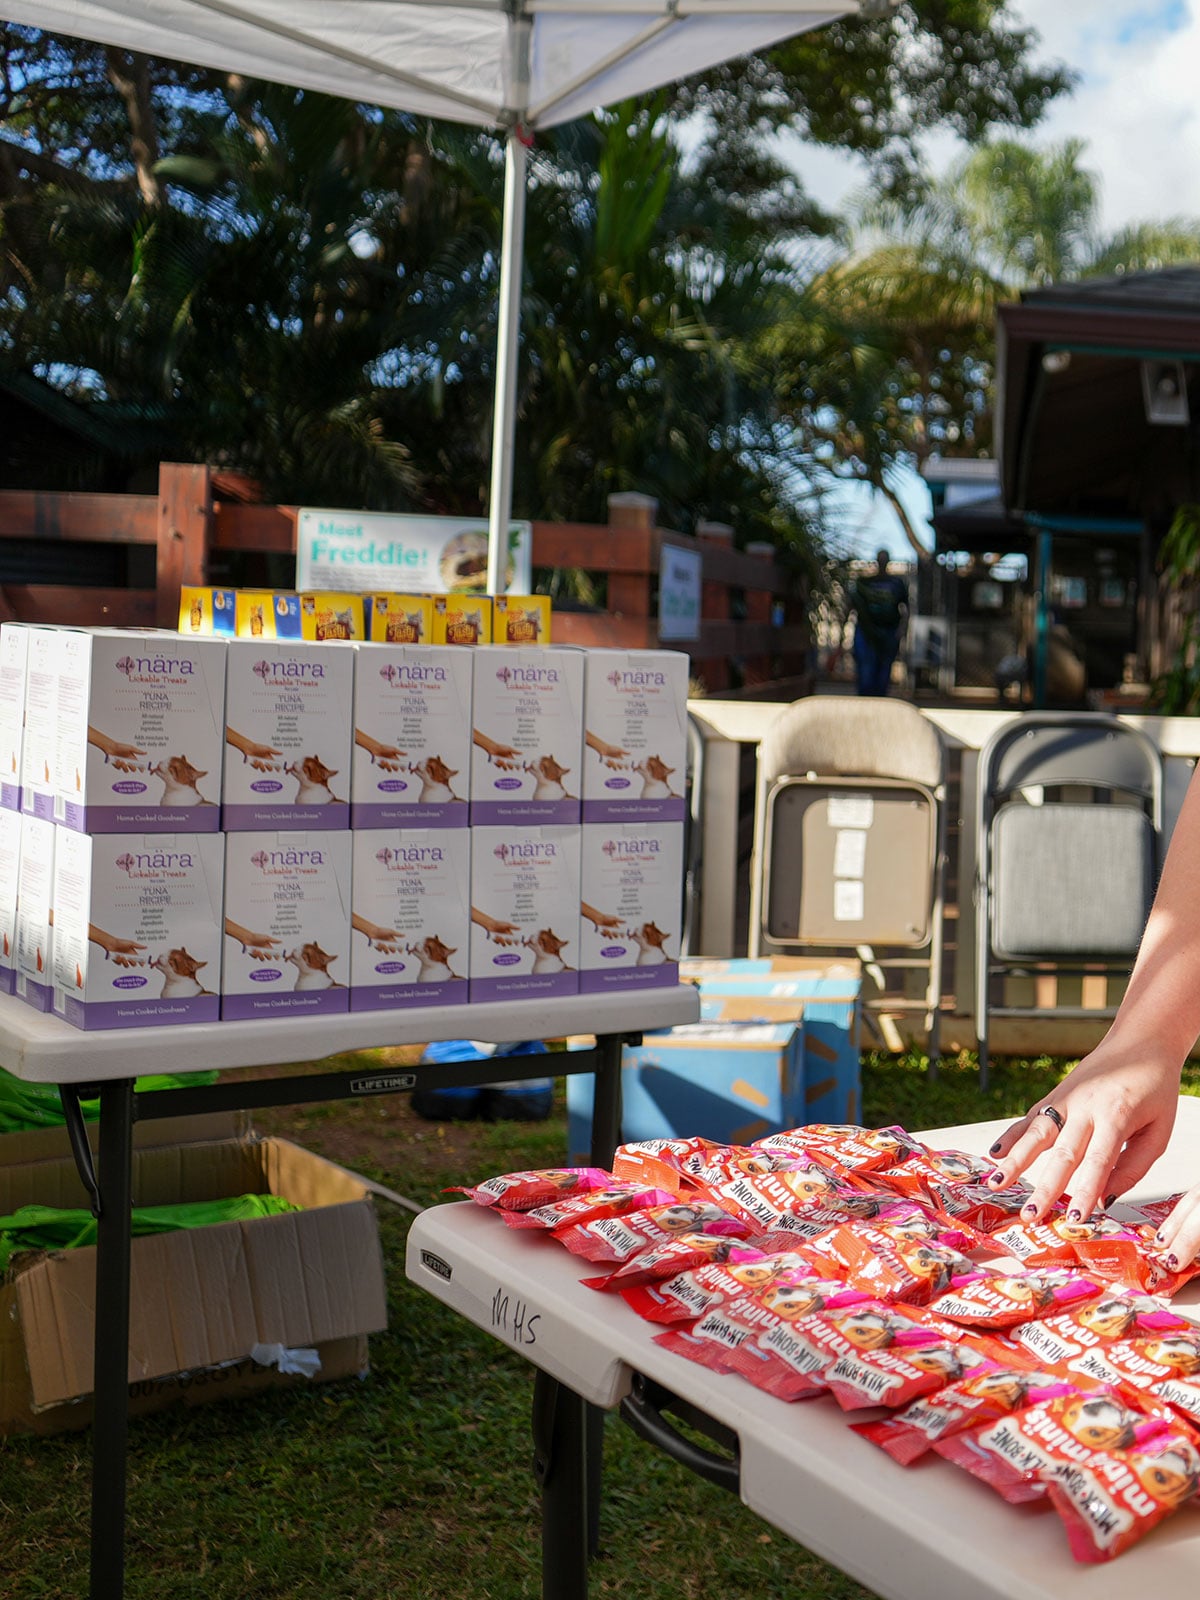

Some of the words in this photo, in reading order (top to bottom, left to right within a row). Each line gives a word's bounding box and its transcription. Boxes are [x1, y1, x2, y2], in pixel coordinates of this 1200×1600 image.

[318, 521, 363, 538] Meet
[310, 539, 428, 568] Freddie!
[128, 675, 160, 683] Lickable
[162, 676, 187, 684] Treats
[264, 678, 293, 686] Lickable
[296, 679, 318, 687] Treats
[143, 692, 168, 700] TUNA
[278, 695, 302, 703] TUNA
[140, 701, 172, 710] RECIPE
[274, 704, 304, 712] RECIPE
[136, 850, 194, 868] nära
[128, 870, 160, 879] Lickable
[162, 870, 186, 878] Treats
[262, 867, 292, 876] Lickable
[295, 867, 318, 875] Treats
[143, 888, 168, 896] TUNA
[274, 892, 304, 900] RECIPE
[140, 896, 171, 904] RECIPE
[357, 1077, 408, 1089] LIFETIME
[423, 1253, 450, 1278] LIFETIME
[695, 1263, 744, 1295] minis
[491, 1287, 541, 1344] MHS
[1107, 1345, 1171, 1377] minis
[1022, 1408, 1092, 1463] minis
